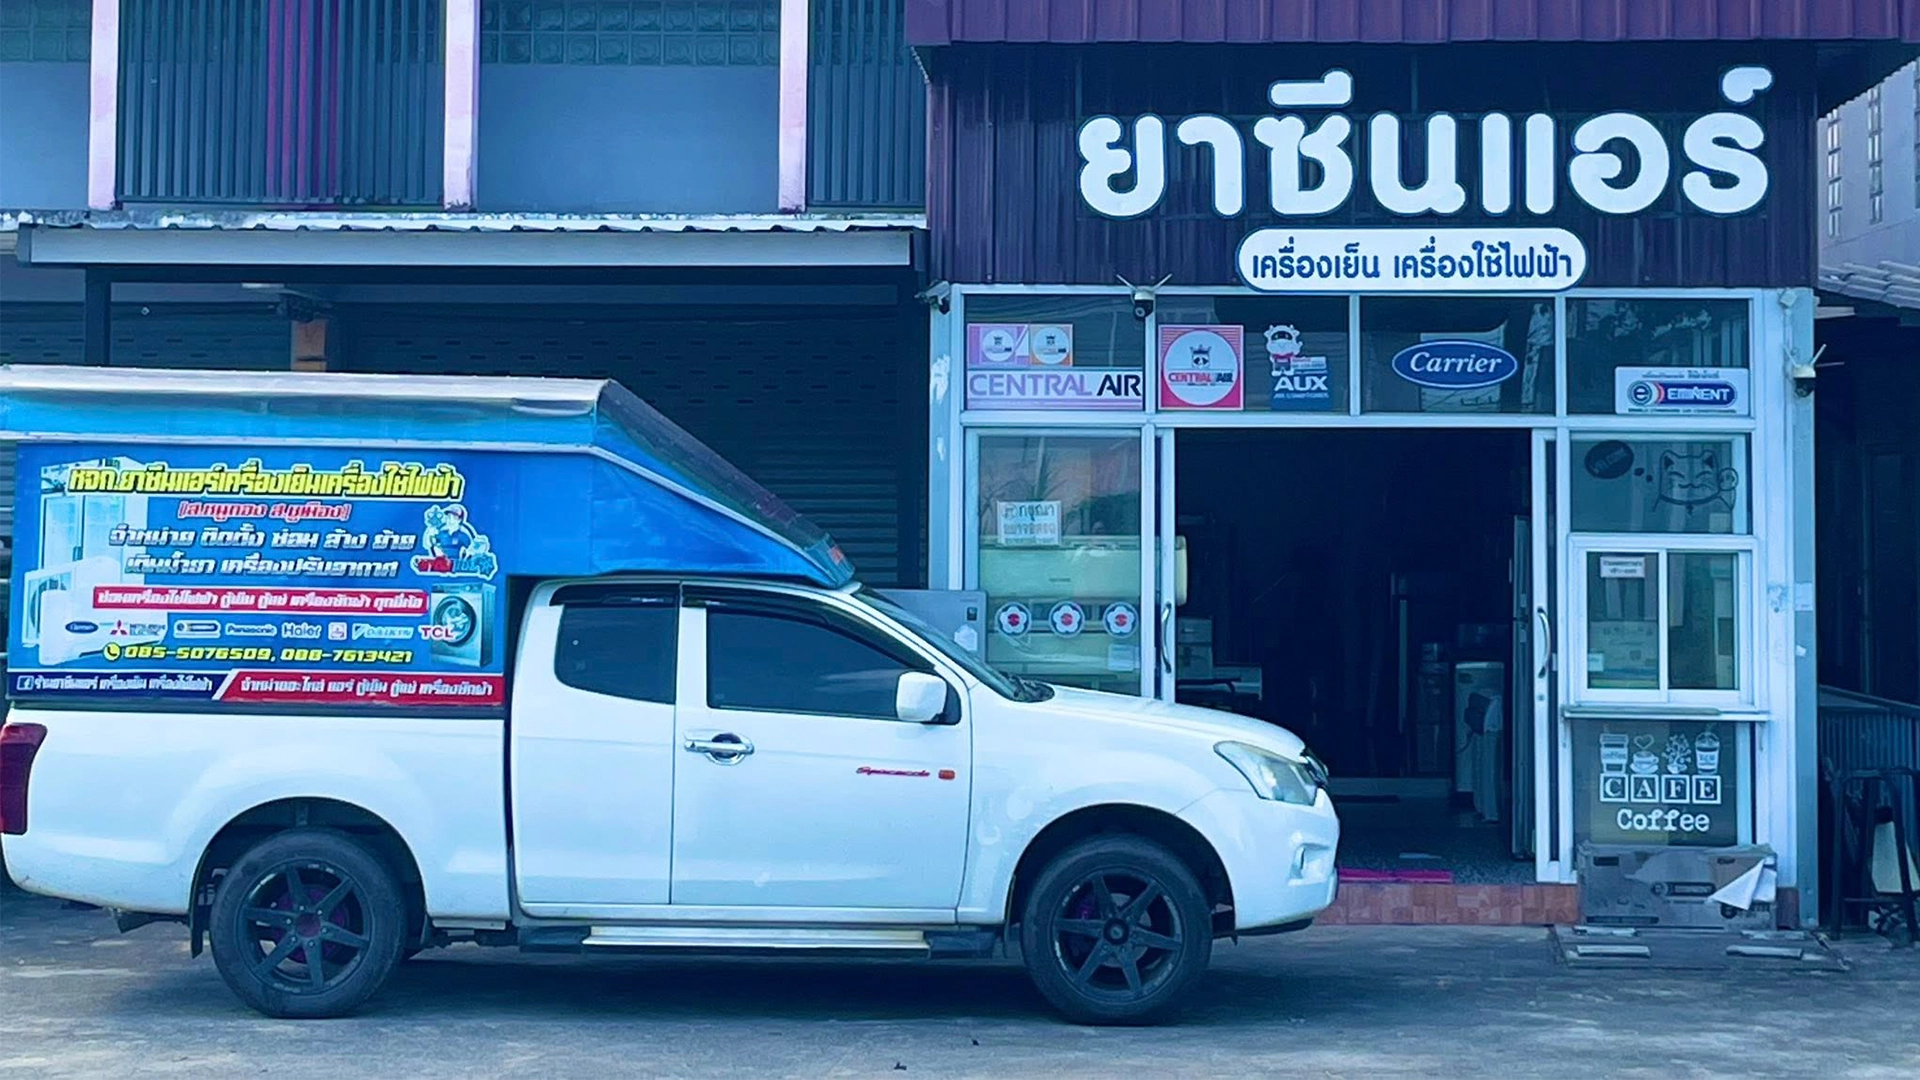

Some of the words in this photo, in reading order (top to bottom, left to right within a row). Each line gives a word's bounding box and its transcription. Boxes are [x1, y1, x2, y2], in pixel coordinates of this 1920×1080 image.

[1078, 67, 1773, 218] ยาซีนแอร์
[1252, 236, 1380, 279] เครื่องเย็น
[1394, 236, 1573, 279] เครื่องใช้ไฟฟ้า
[1410, 352, 1503, 374] Carrier
[969, 374, 1092, 396] CENTRAL
[1096, 374, 1141, 397] AIR
[1168, 373, 1212, 383] CENTRAL
[1274, 376, 1328, 391] AUX
[110, 524, 195, 546] จำหน่าย
[201, 524, 265, 547] ติดตั้ง
[283, 623, 320, 636] Haier
[422, 625, 453, 637] TCL
[1604, 777, 1715, 800] CAFE
[1616, 808, 1710, 832] Coffee
